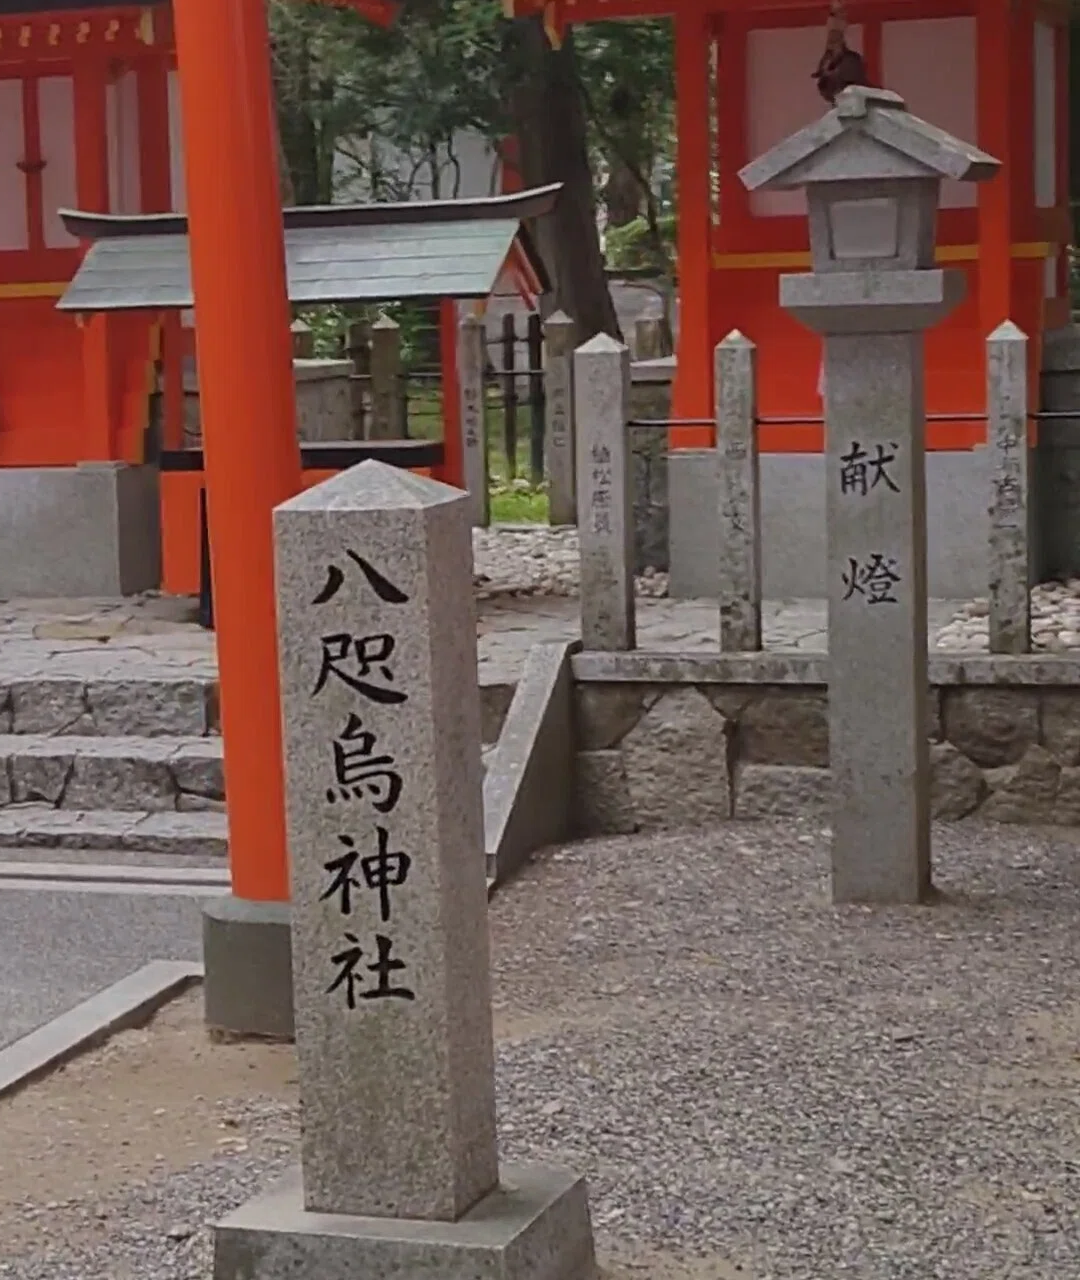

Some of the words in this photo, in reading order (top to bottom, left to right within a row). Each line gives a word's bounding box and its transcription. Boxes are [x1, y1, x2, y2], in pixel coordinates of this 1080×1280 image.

[840, 441, 901, 605] 献燈
[311, 548, 416, 1010] 八咫烏神社
